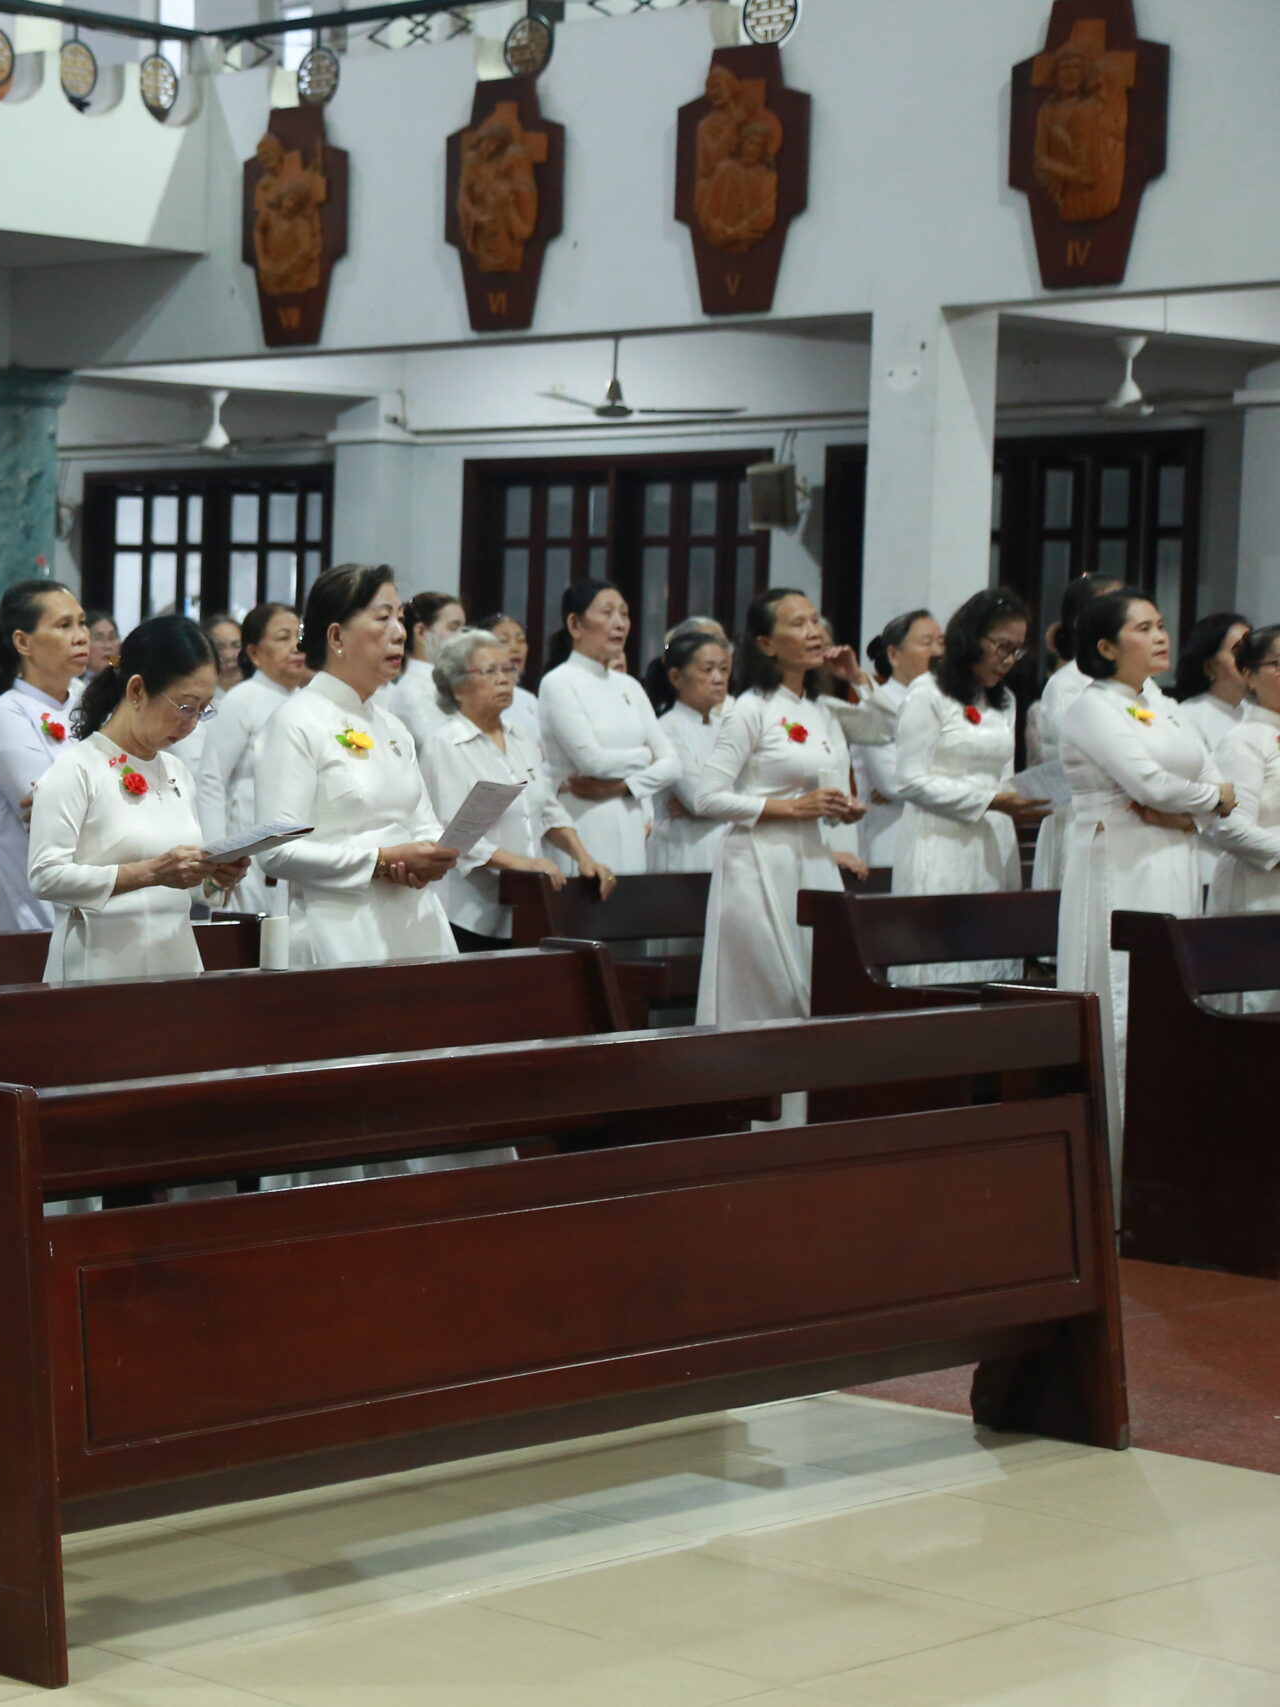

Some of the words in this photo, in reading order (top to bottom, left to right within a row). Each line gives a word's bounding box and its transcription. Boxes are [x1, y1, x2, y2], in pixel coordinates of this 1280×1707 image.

[1066, 239, 1092, 267] IV
[724, 272, 742, 298] V
[488, 291, 508, 314] VI
